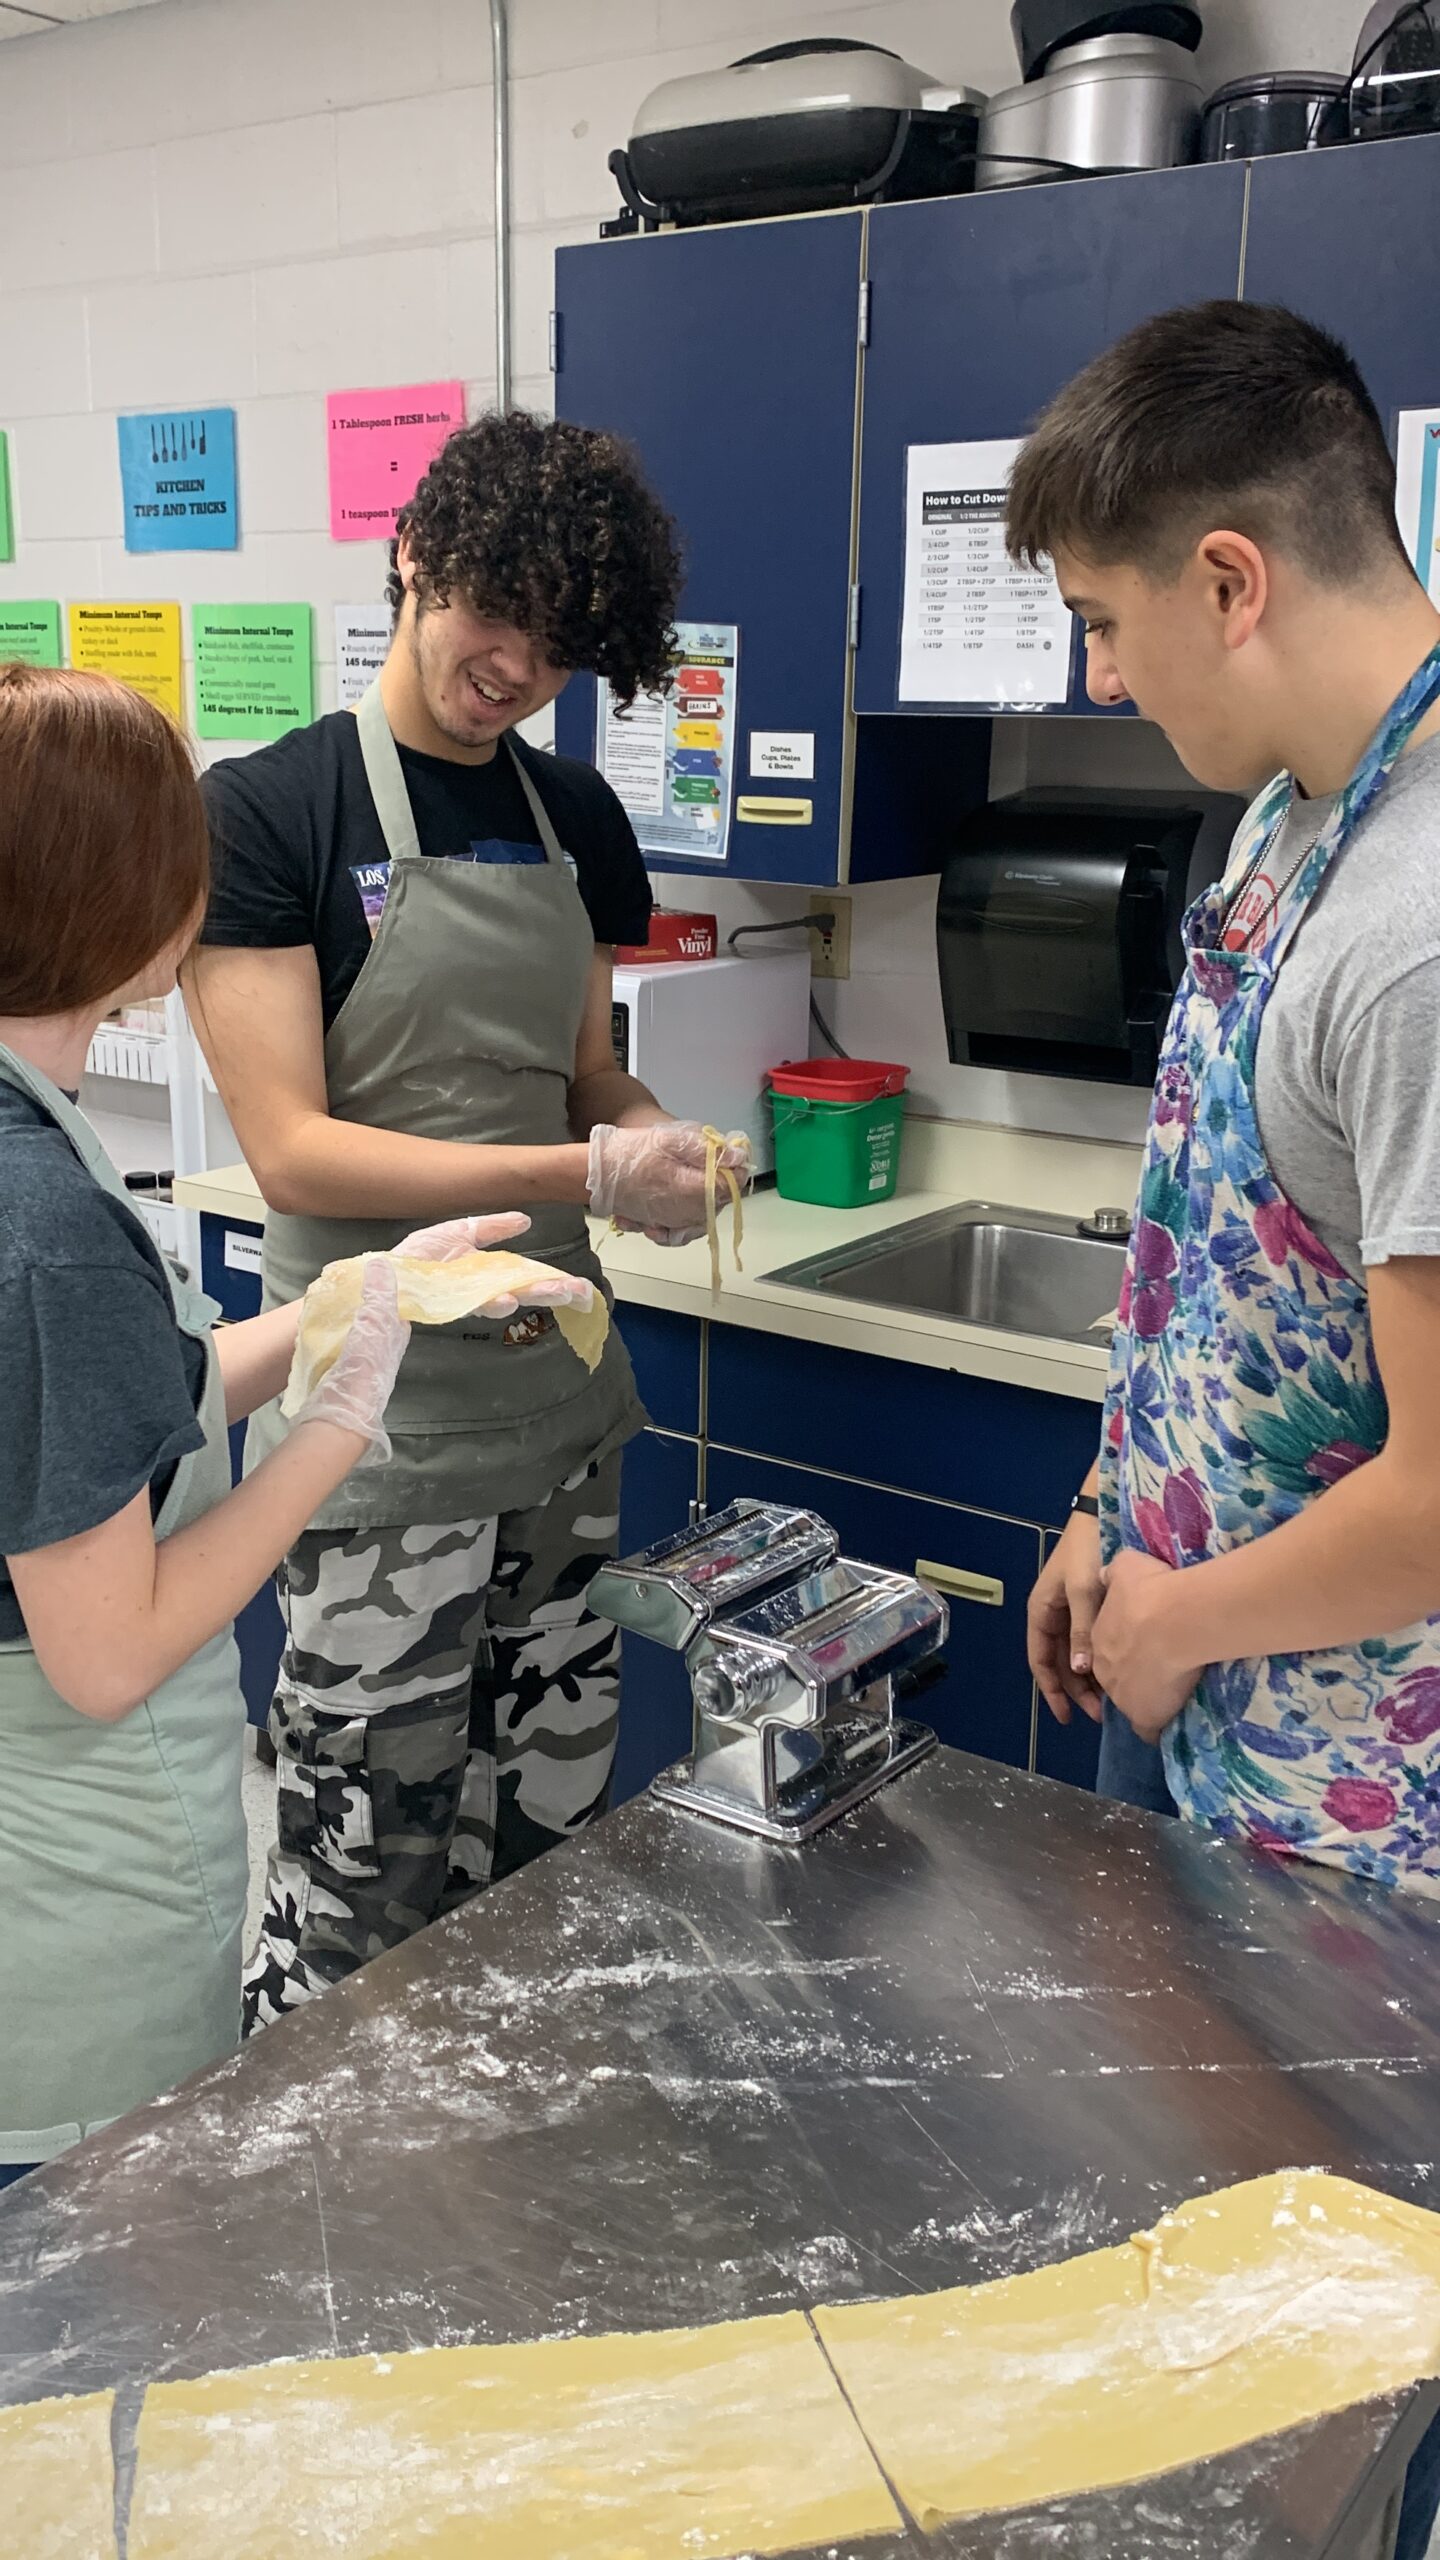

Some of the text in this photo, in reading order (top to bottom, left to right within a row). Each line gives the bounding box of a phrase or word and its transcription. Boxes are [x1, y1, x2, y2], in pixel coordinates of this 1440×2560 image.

[332, 411, 450, 430] 1 Tablespoon FRESH herbs
[155, 478, 205, 494] KITCHEN
[925, 496, 949, 505] How
[950, 495, 961, 505] to
[962, 494, 980, 504] Cut
[133, 501, 227, 517] TIPS AND TRICKS
[348, 509, 389, 521] teaspoon
[79, 610, 162, 620] Minimum Internal Temps
[5, 622, 28, 630] Internal
[30, 622, 48, 631] Temps
[204, 626, 293, 637] Minimum Internal Temps
[347, 628, 387, 637] Minimum
[345, 657, 360, 666] 145
[203, 704, 216, 712] 145
[218, 704, 246, 715] degrees
[254, 706, 263, 714] for
[265, 706, 273, 714] 15
[356, 869, 386, 888] LOS
[677, 936, 712, 957] Vinyl
[232, 1244, 263, 1257] SILVERWA
